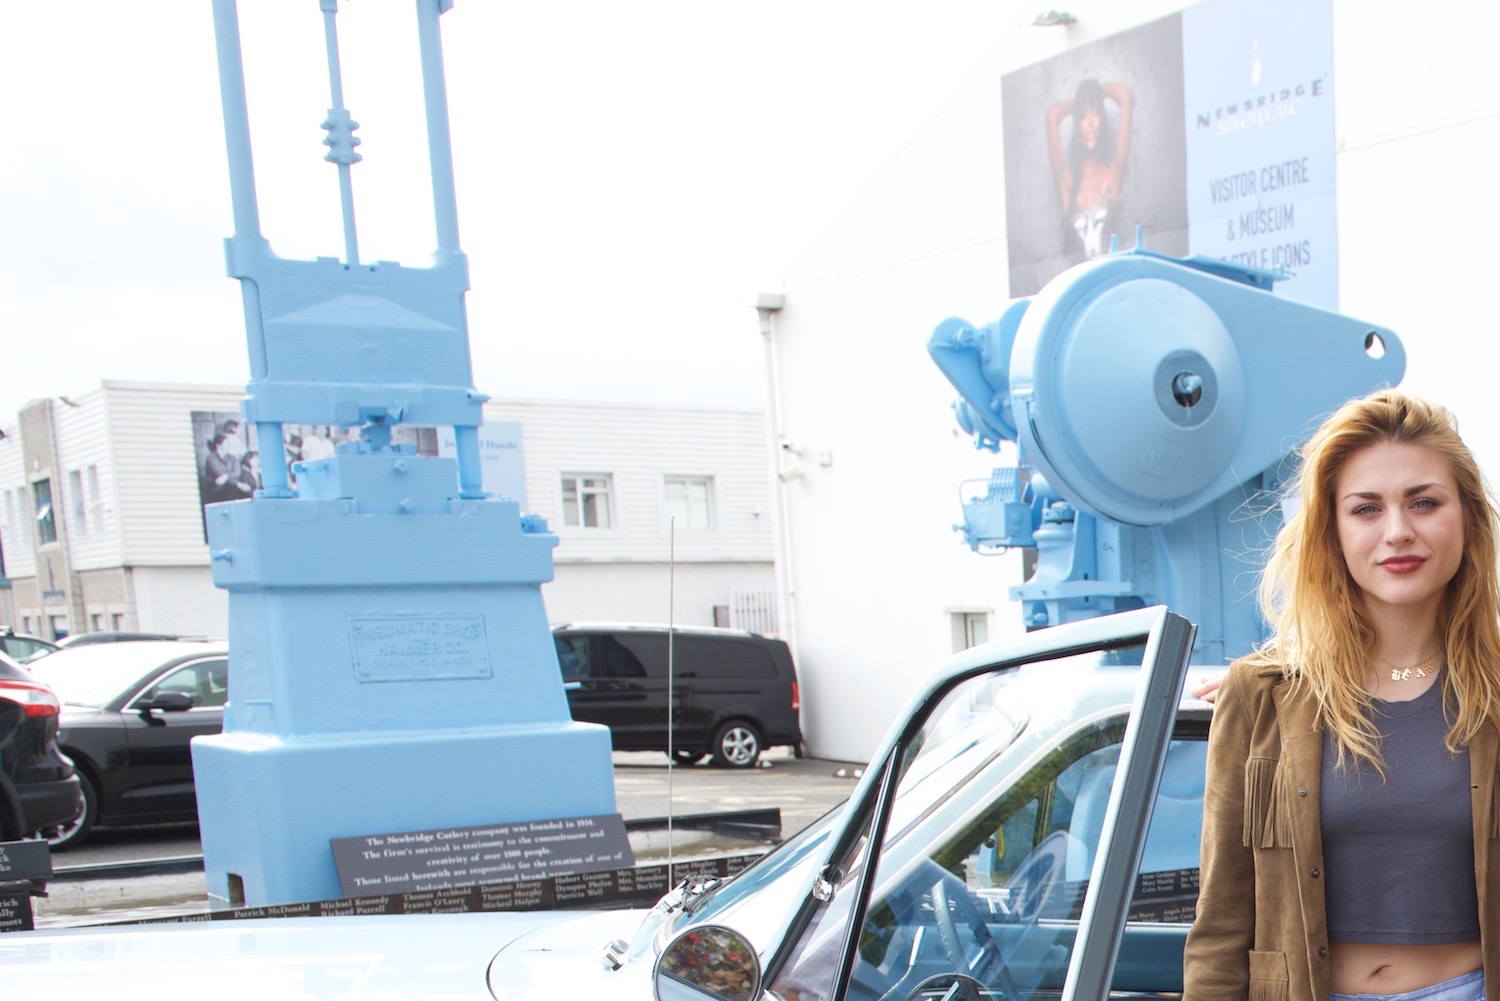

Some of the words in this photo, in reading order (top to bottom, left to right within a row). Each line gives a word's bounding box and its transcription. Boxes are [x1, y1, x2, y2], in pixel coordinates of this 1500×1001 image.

[1210, 170, 1257, 205] VISITOR
[1260, 157, 1309, 193] CENTRE
[1227, 219, 1236, 241] &
[1239, 203, 1295, 238] MUSEUM
[366, 838, 384, 847] The
[387, 832, 434, 845] Newbridge
[436, 830, 469, 842] Cutlery
[472, 827, 509, 837] company
[530, 820, 563, 831] founded
[566, 820, 575, 828] in
[362, 851, 381, 859] The
[383, 847, 413, 857] firm's
[415, 843, 450, 855] survival
[452, 843, 460, 851] is
[462, 839, 504, 850] testimony
[507, 838, 516, 846] to
[518, 837, 532, 845] the
[534, 832, 587, 843] commitment
[589, 829, 605, 838] and
[427, 854, 467, 866] creativity
[470, 853, 480, 862] of
[484, 852, 501, 861] over
[524, 847, 553, 859] people.
[354, 877, 382, 887] Those
[384, 873, 409, 884] listed
[412, 869, 451, 880] herewith
[453, 869, 466, 877] are
[469, 863, 515, 875] responsible
[518, 860, 530, 869] for
[533, 860, 547, 869] the
[550, 856, 583, 867] creation
[585, 854, 595, 863] of
[613, 851, 623, 860] of
[403, 892, 434, 901] Thomas
[436, 887, 471, 898] Archbold
[481, 884, 513, 893] Dominic
[557, 890, 585, 900] Patricia
[320, 898, 352, 910] Michael
[354, 895, 389, 906] Kennedy
[482, 892, 511, 901] Thomas
[234, 909, 265, 919] Patrick
[268, 903, 310, 914] McDonald
[356, 905, 385, 915] Purcell
[403, 900, 432, 910] Francis
